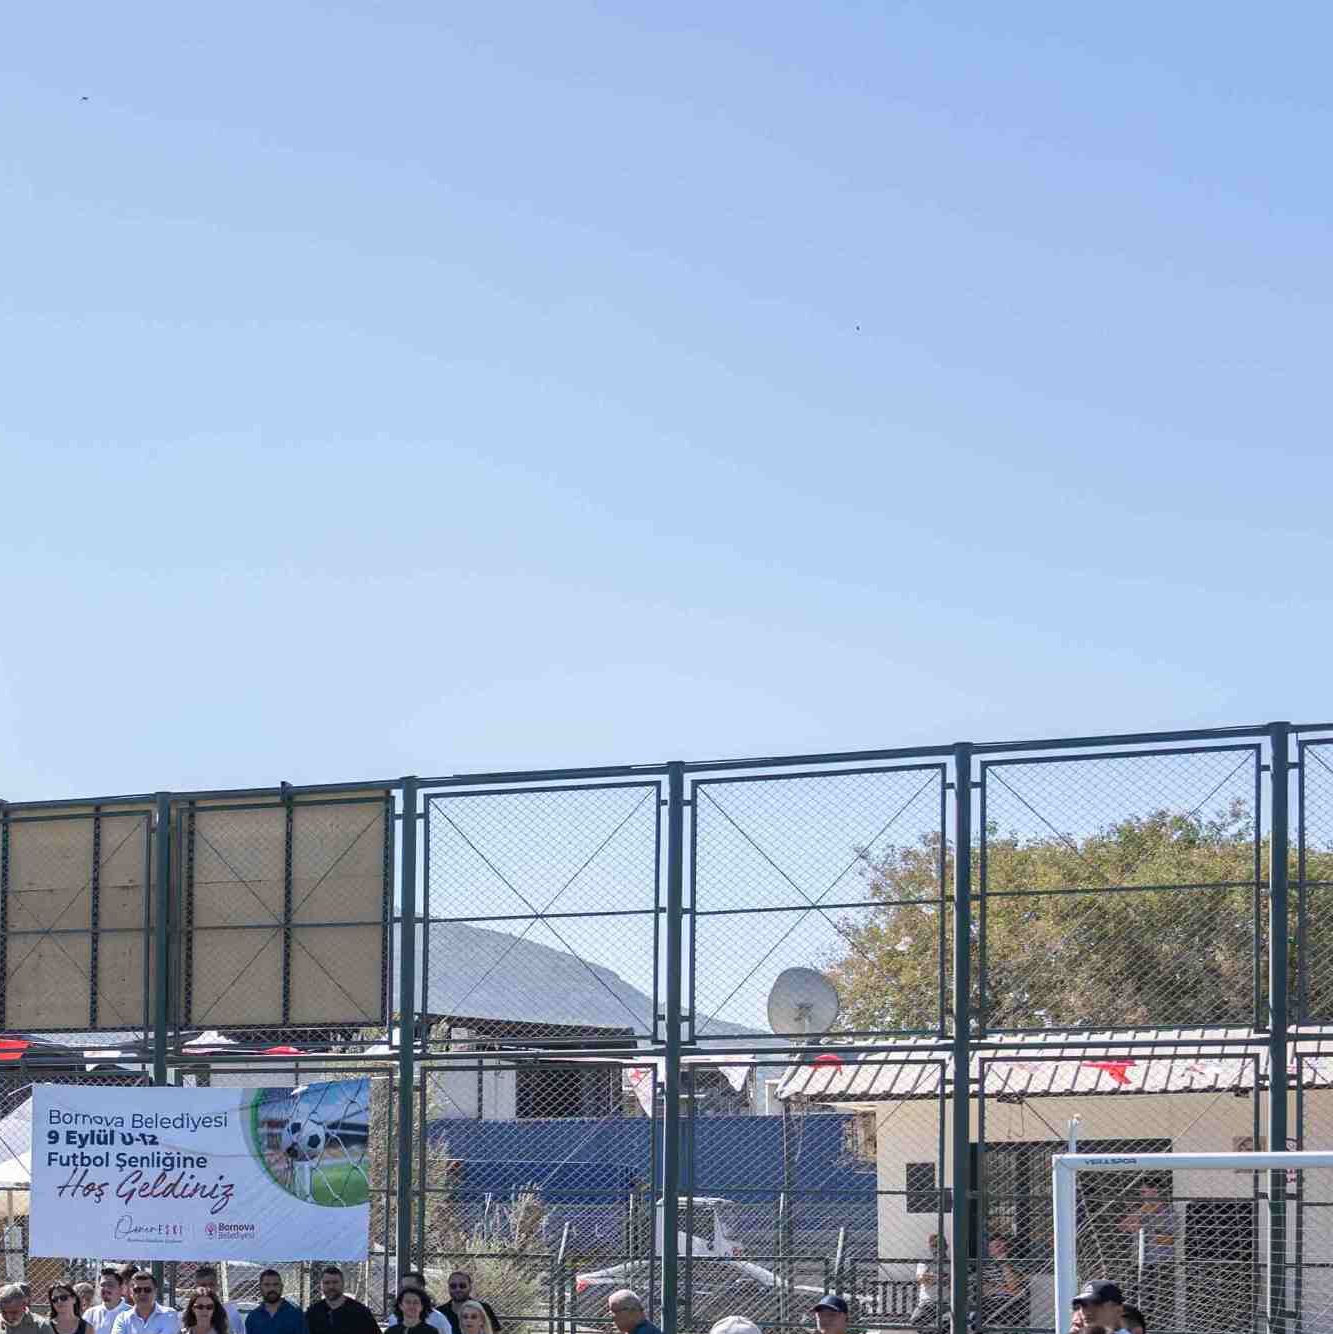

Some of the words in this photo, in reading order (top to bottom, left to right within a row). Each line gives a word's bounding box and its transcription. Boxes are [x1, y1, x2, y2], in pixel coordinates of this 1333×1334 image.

[49, 1109, 125, 1128] Bornova
[131, 1111, 228, 1133] Belediyesi
[47, 1130, 60, 1145] 9
[65, 1130, 115, 1149] Eylül
[47, 1152, 110, 1168] Futbol
[115, 1152, 208, 1172] Şenliğine
[57, 1168, 110, 1204] Hoş
[116, 1167, 236, 1215] Geldiniz
[218, 1222, 255, 1232] Bornova
